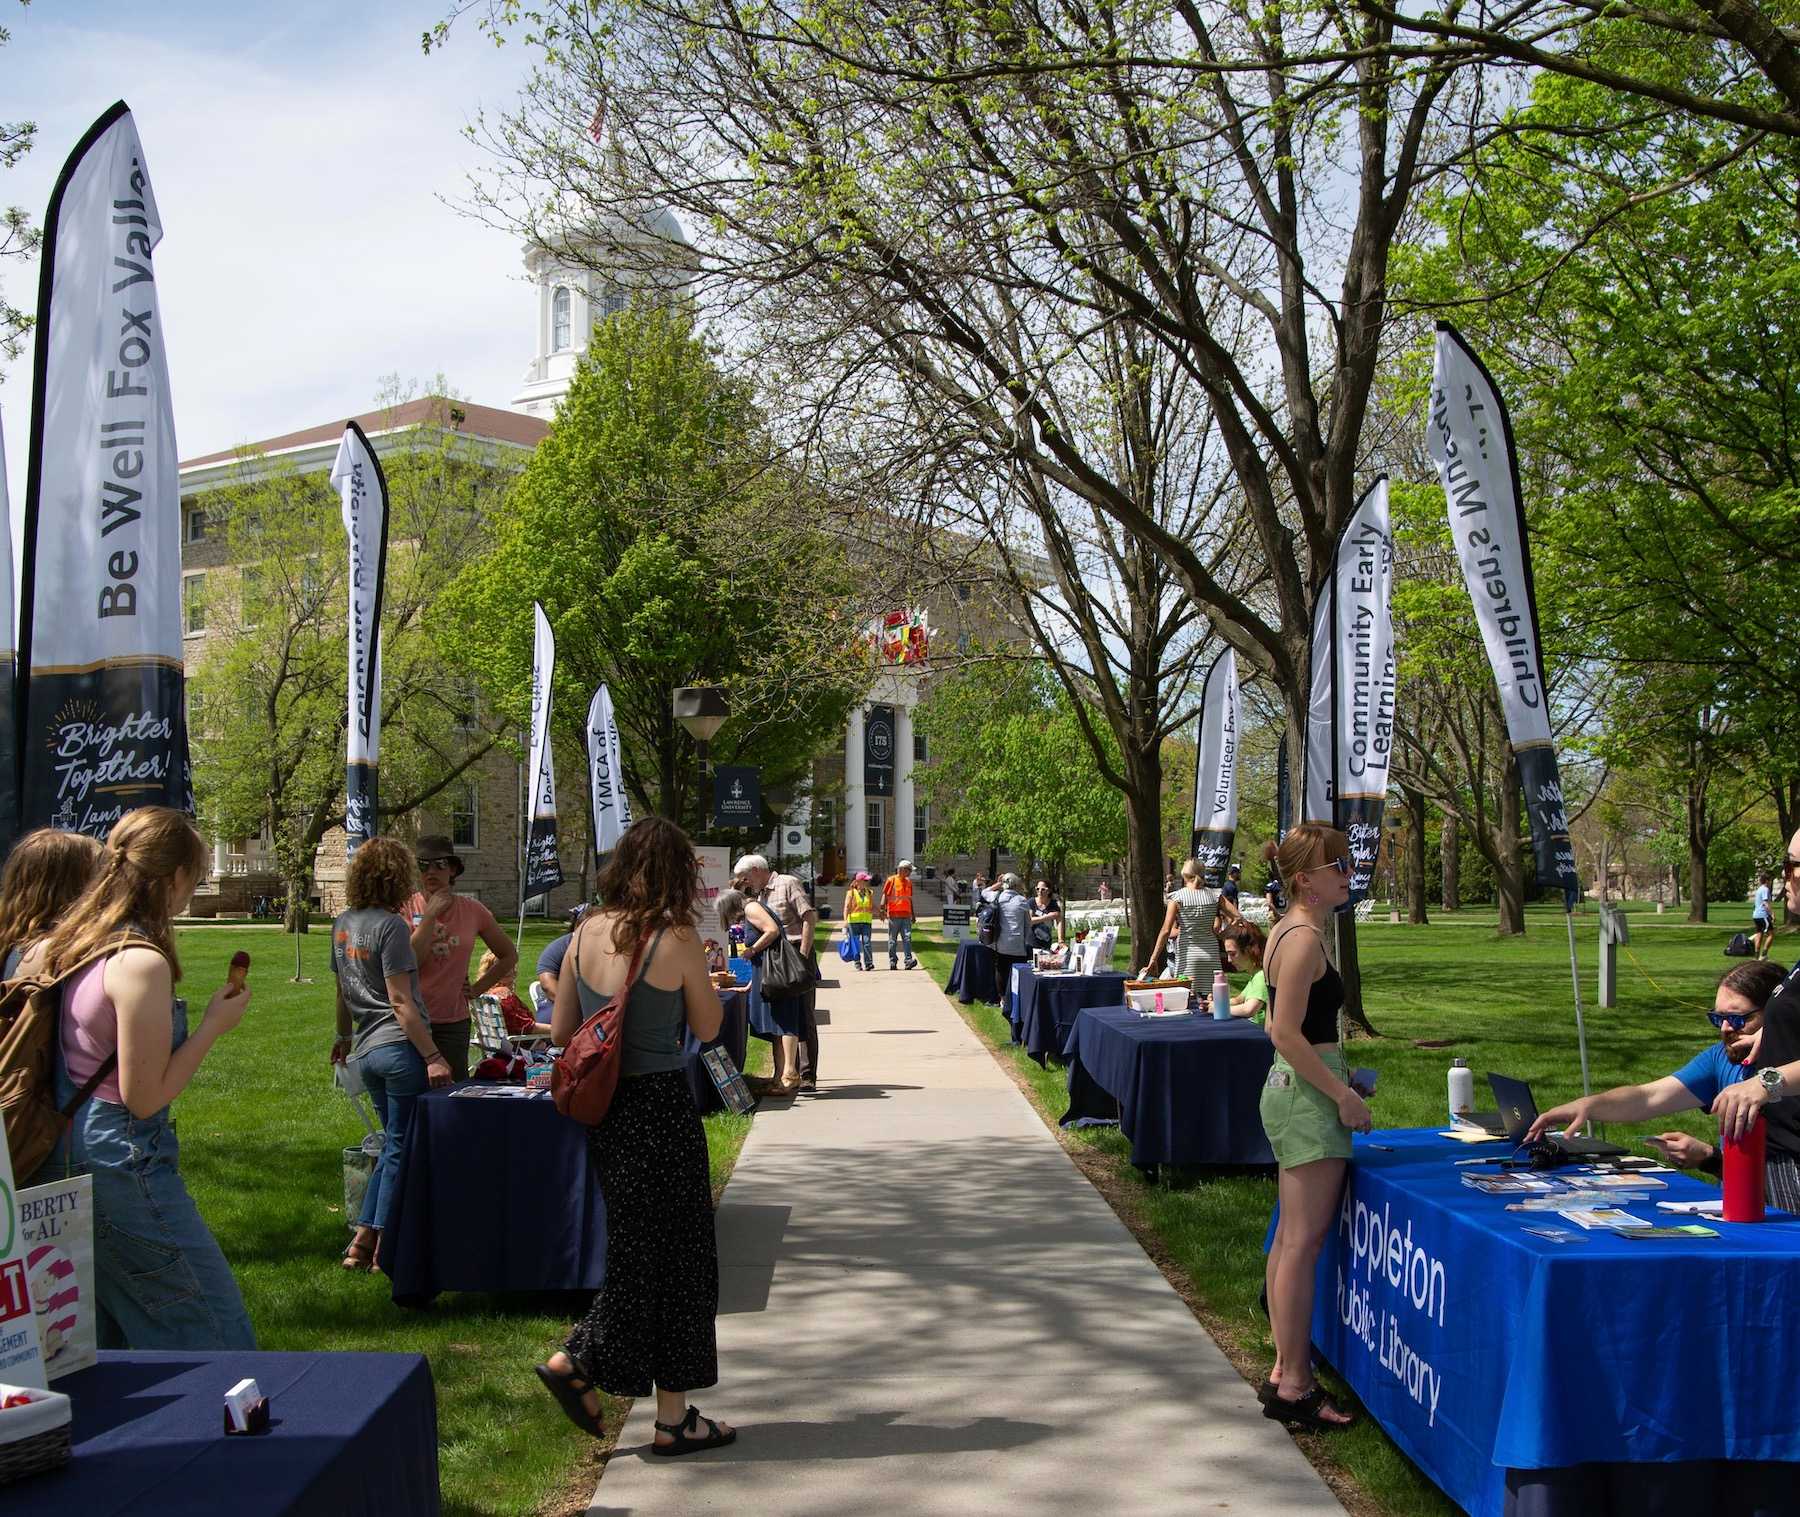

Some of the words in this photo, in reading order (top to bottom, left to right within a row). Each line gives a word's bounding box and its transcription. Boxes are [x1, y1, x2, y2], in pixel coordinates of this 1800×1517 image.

[112, 156, 155, 294] Valle
[106, 308, 153, 399] Fox
[101, 420, 146, 538] Well
[97, 548, 139, 619] Be
[1350, 522, 1384, 593] Early
[1347, 603, 1376, 777] Community
[56, 711, 173, 757] Brighter
[592, 727, 606, 748] of
[55, 750, 172, 801] Together!
[596, 754, 614, 812] YMCA
[1213, 737, 1236, 814] Volunteer
[20, 1191, 80, 1223] BERTY
[1339, 1178, 1446, 1328] Appleton
[1379, 1309, 1441, 1429] Library
